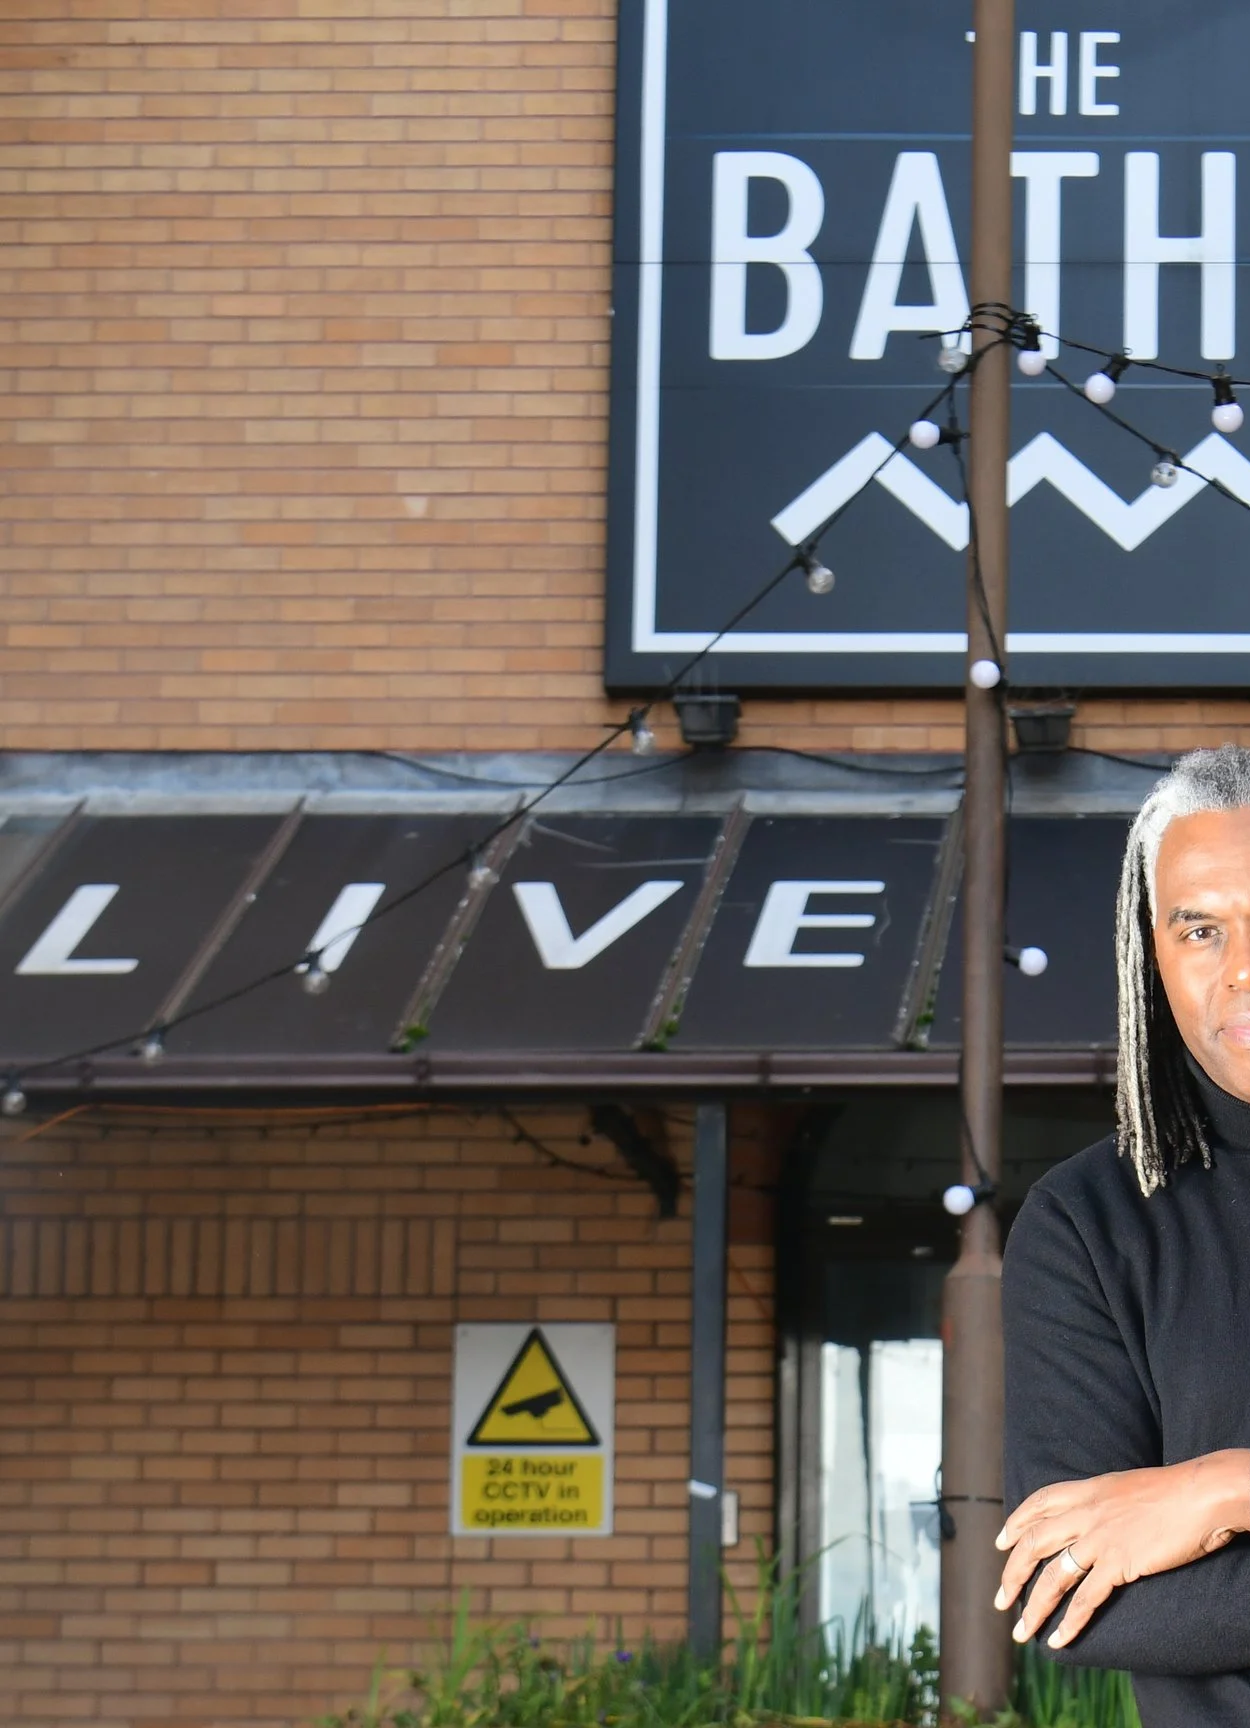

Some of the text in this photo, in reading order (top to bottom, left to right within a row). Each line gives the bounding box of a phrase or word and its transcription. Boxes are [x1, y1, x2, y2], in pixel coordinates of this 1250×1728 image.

[966, 31, 1121, 116] HE
[14, 879, 886, 975] LIVE
[487, 1457, 578, 1476] 24 hour
[482, 1481, 580, 1500] CCTV in
[473, 1506, 588, 1527] operation
